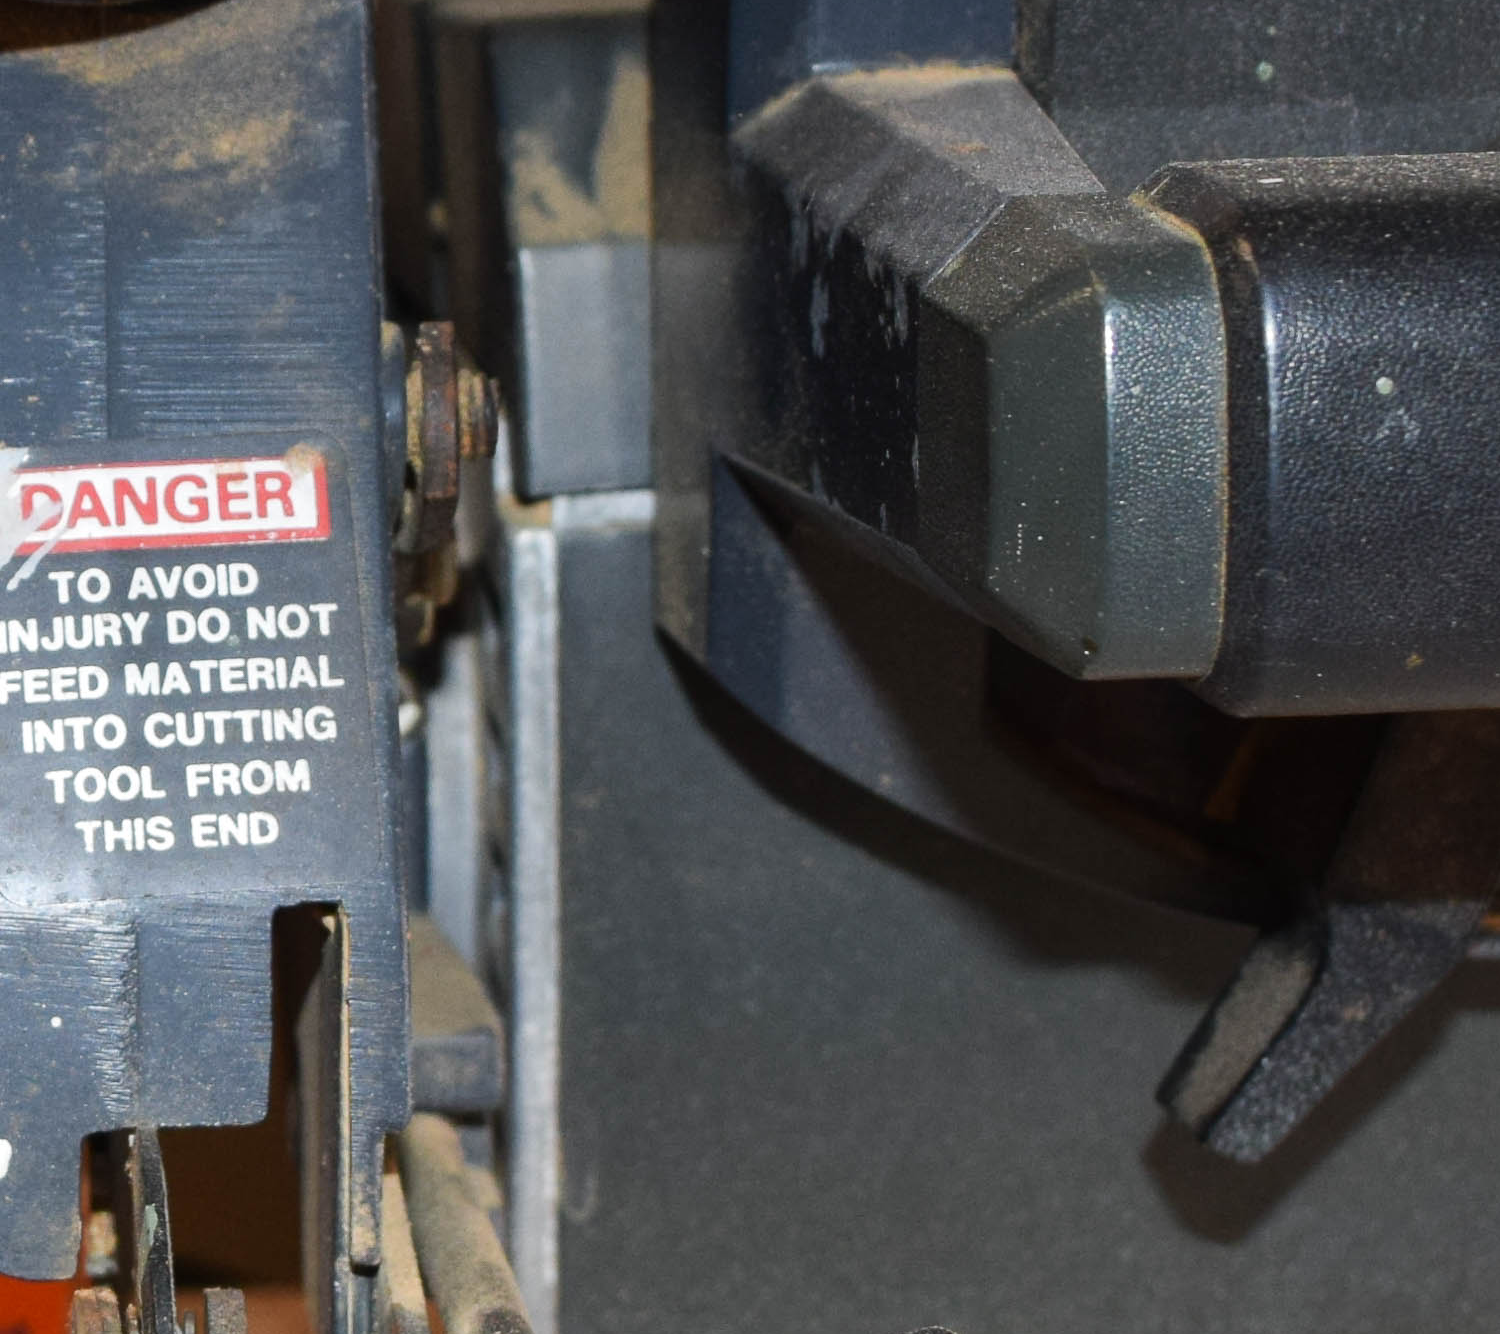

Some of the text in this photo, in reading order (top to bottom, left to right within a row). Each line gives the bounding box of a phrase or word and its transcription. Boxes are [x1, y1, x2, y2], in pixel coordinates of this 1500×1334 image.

[20, 470, 294, 534] DANGER
[49, 563, 258, 603] TO AVOID
[167, 608, 229, 644] DO
[248, 603, 337, 640] NOT
[126, 656, 344, 697] MATERIAL
[22, 706, 337, 753] INTO CUTTING
[46, 759, 310, 804] TOOL FROM
[76, 812, 279, 853] THIS END
